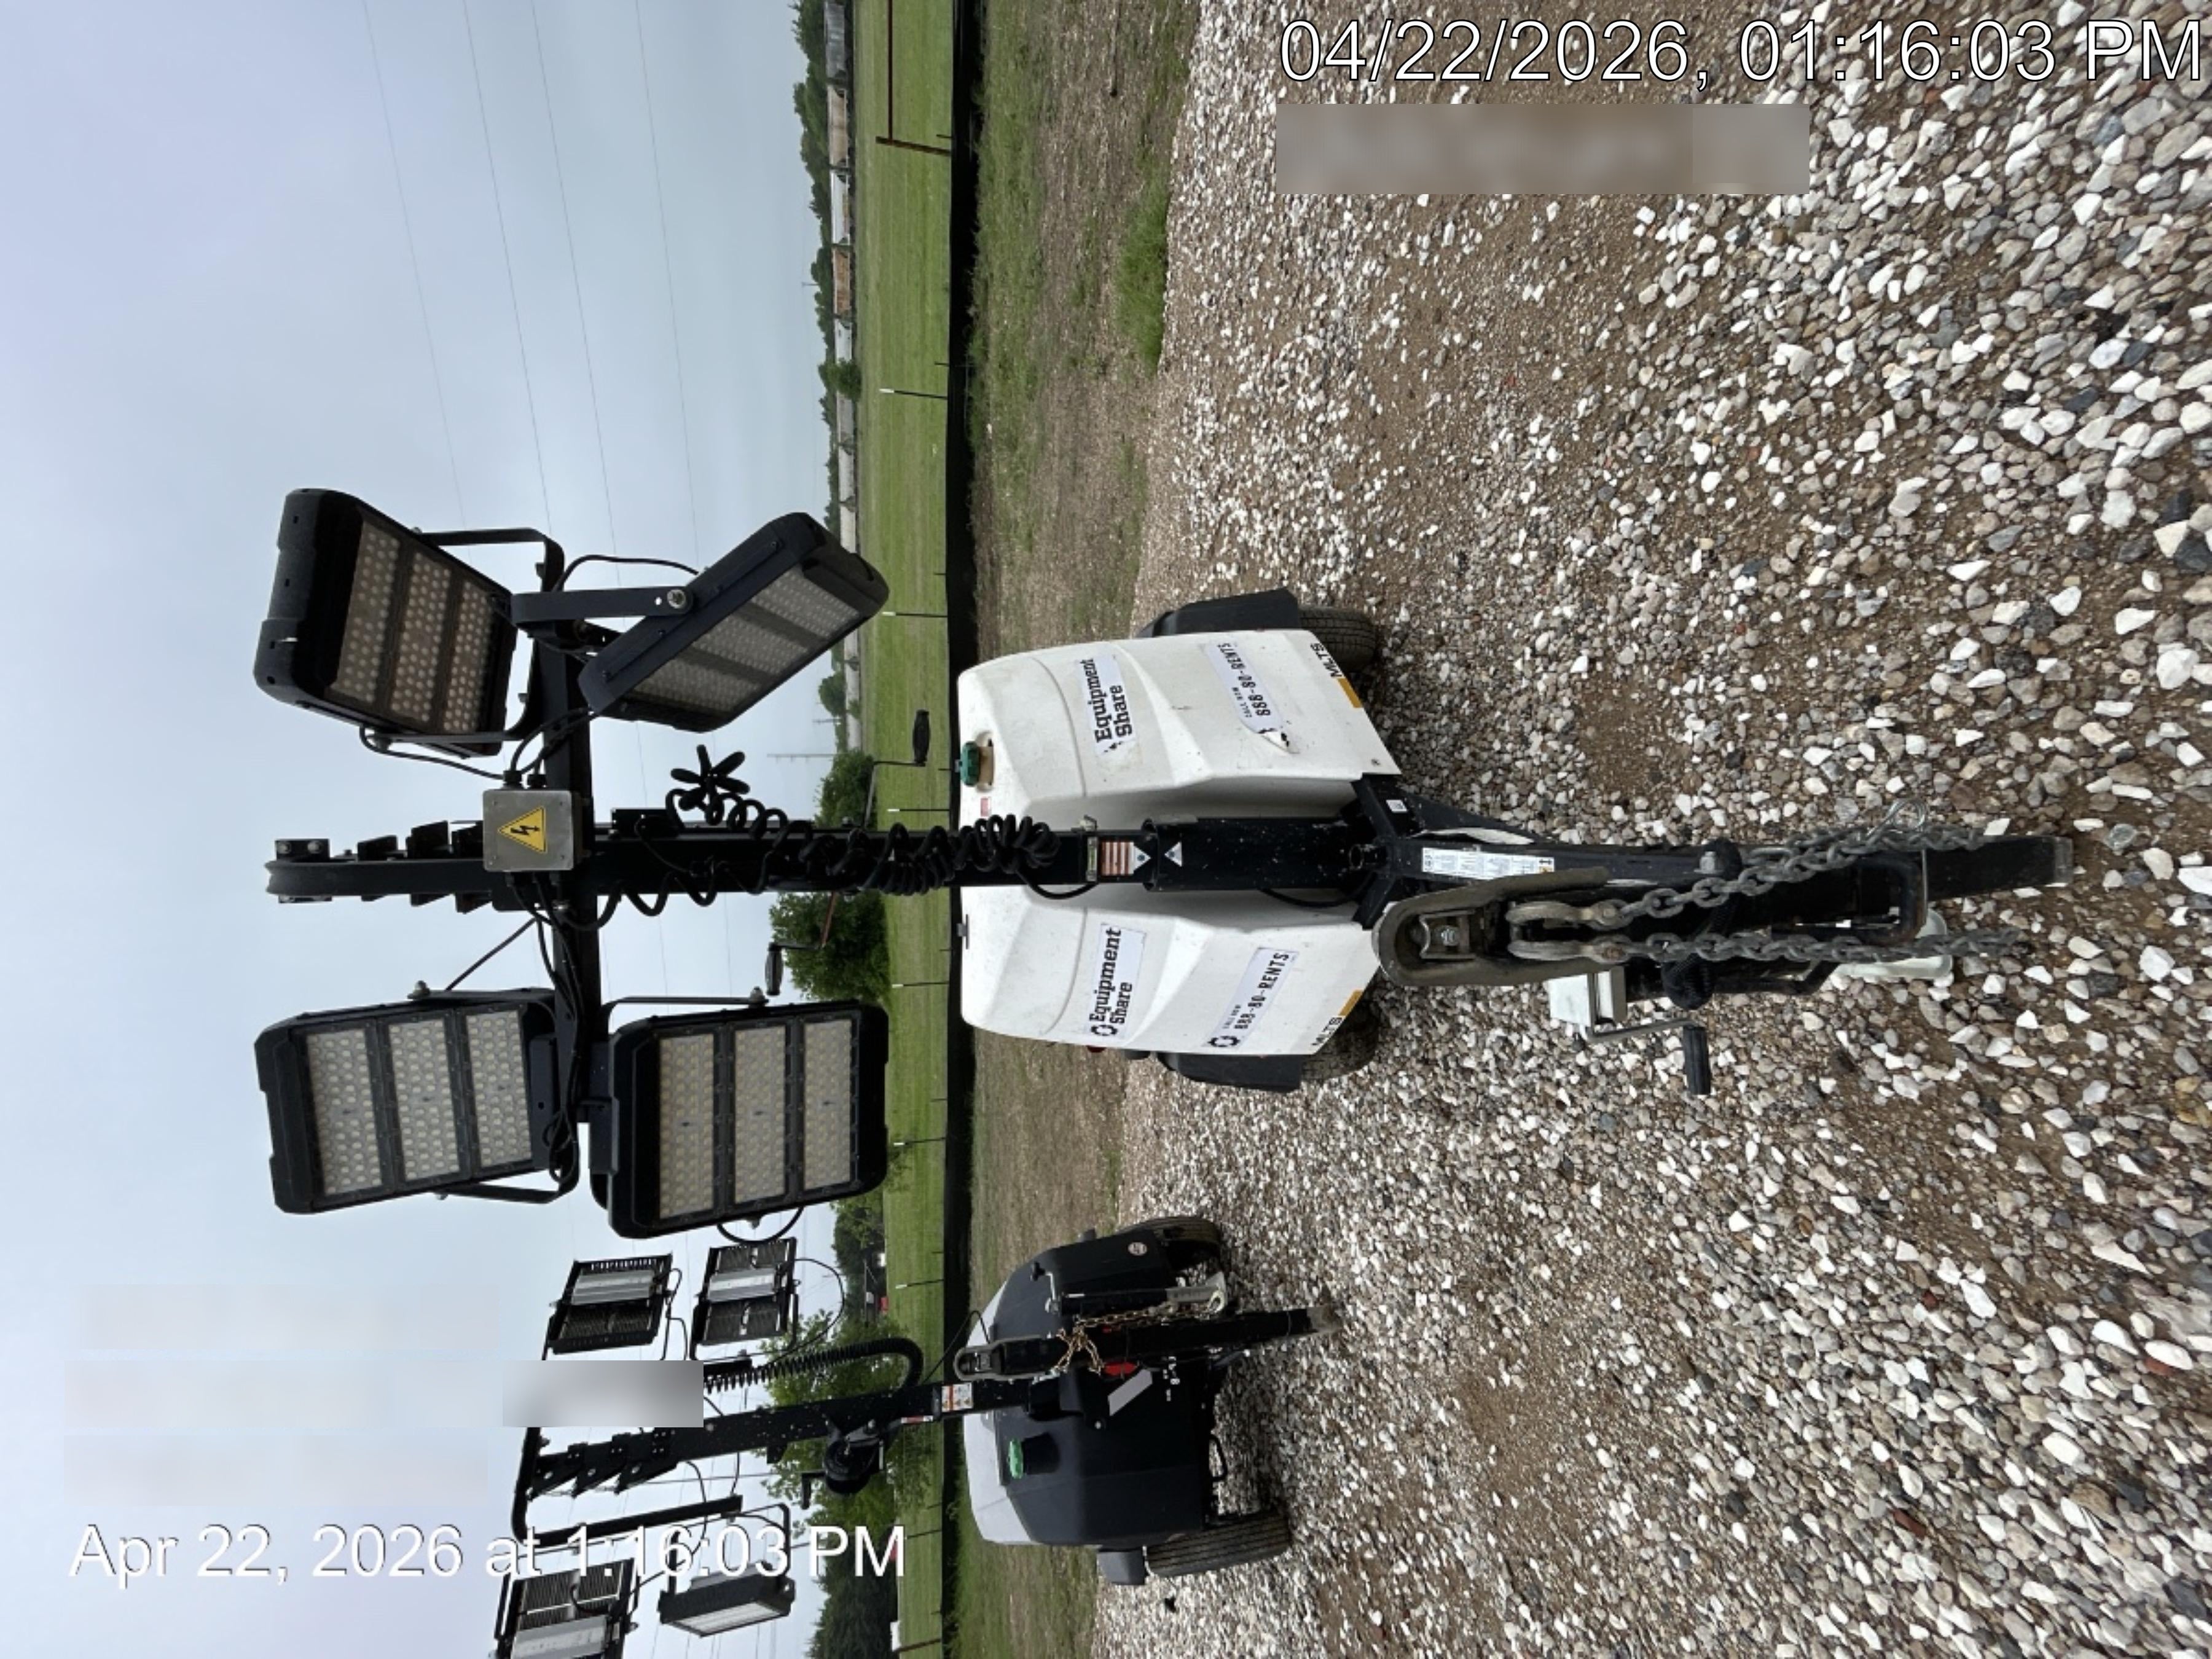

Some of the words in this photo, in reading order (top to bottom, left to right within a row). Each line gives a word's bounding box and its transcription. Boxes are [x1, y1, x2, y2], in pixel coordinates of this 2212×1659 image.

[1217, 643, 1271, 716] 888-80-RENTS
[1310, 643, 1342, 678] MLTS
[1080, 658, 1112, 743] Equipment
[1108, 684, 1132, 737] Share
[1089, 927, 1122, 1022] Equipment
[1108, 982, 1132, 1024] Share
[1234, 952, 1289, 1030] 888-80-RENTS
